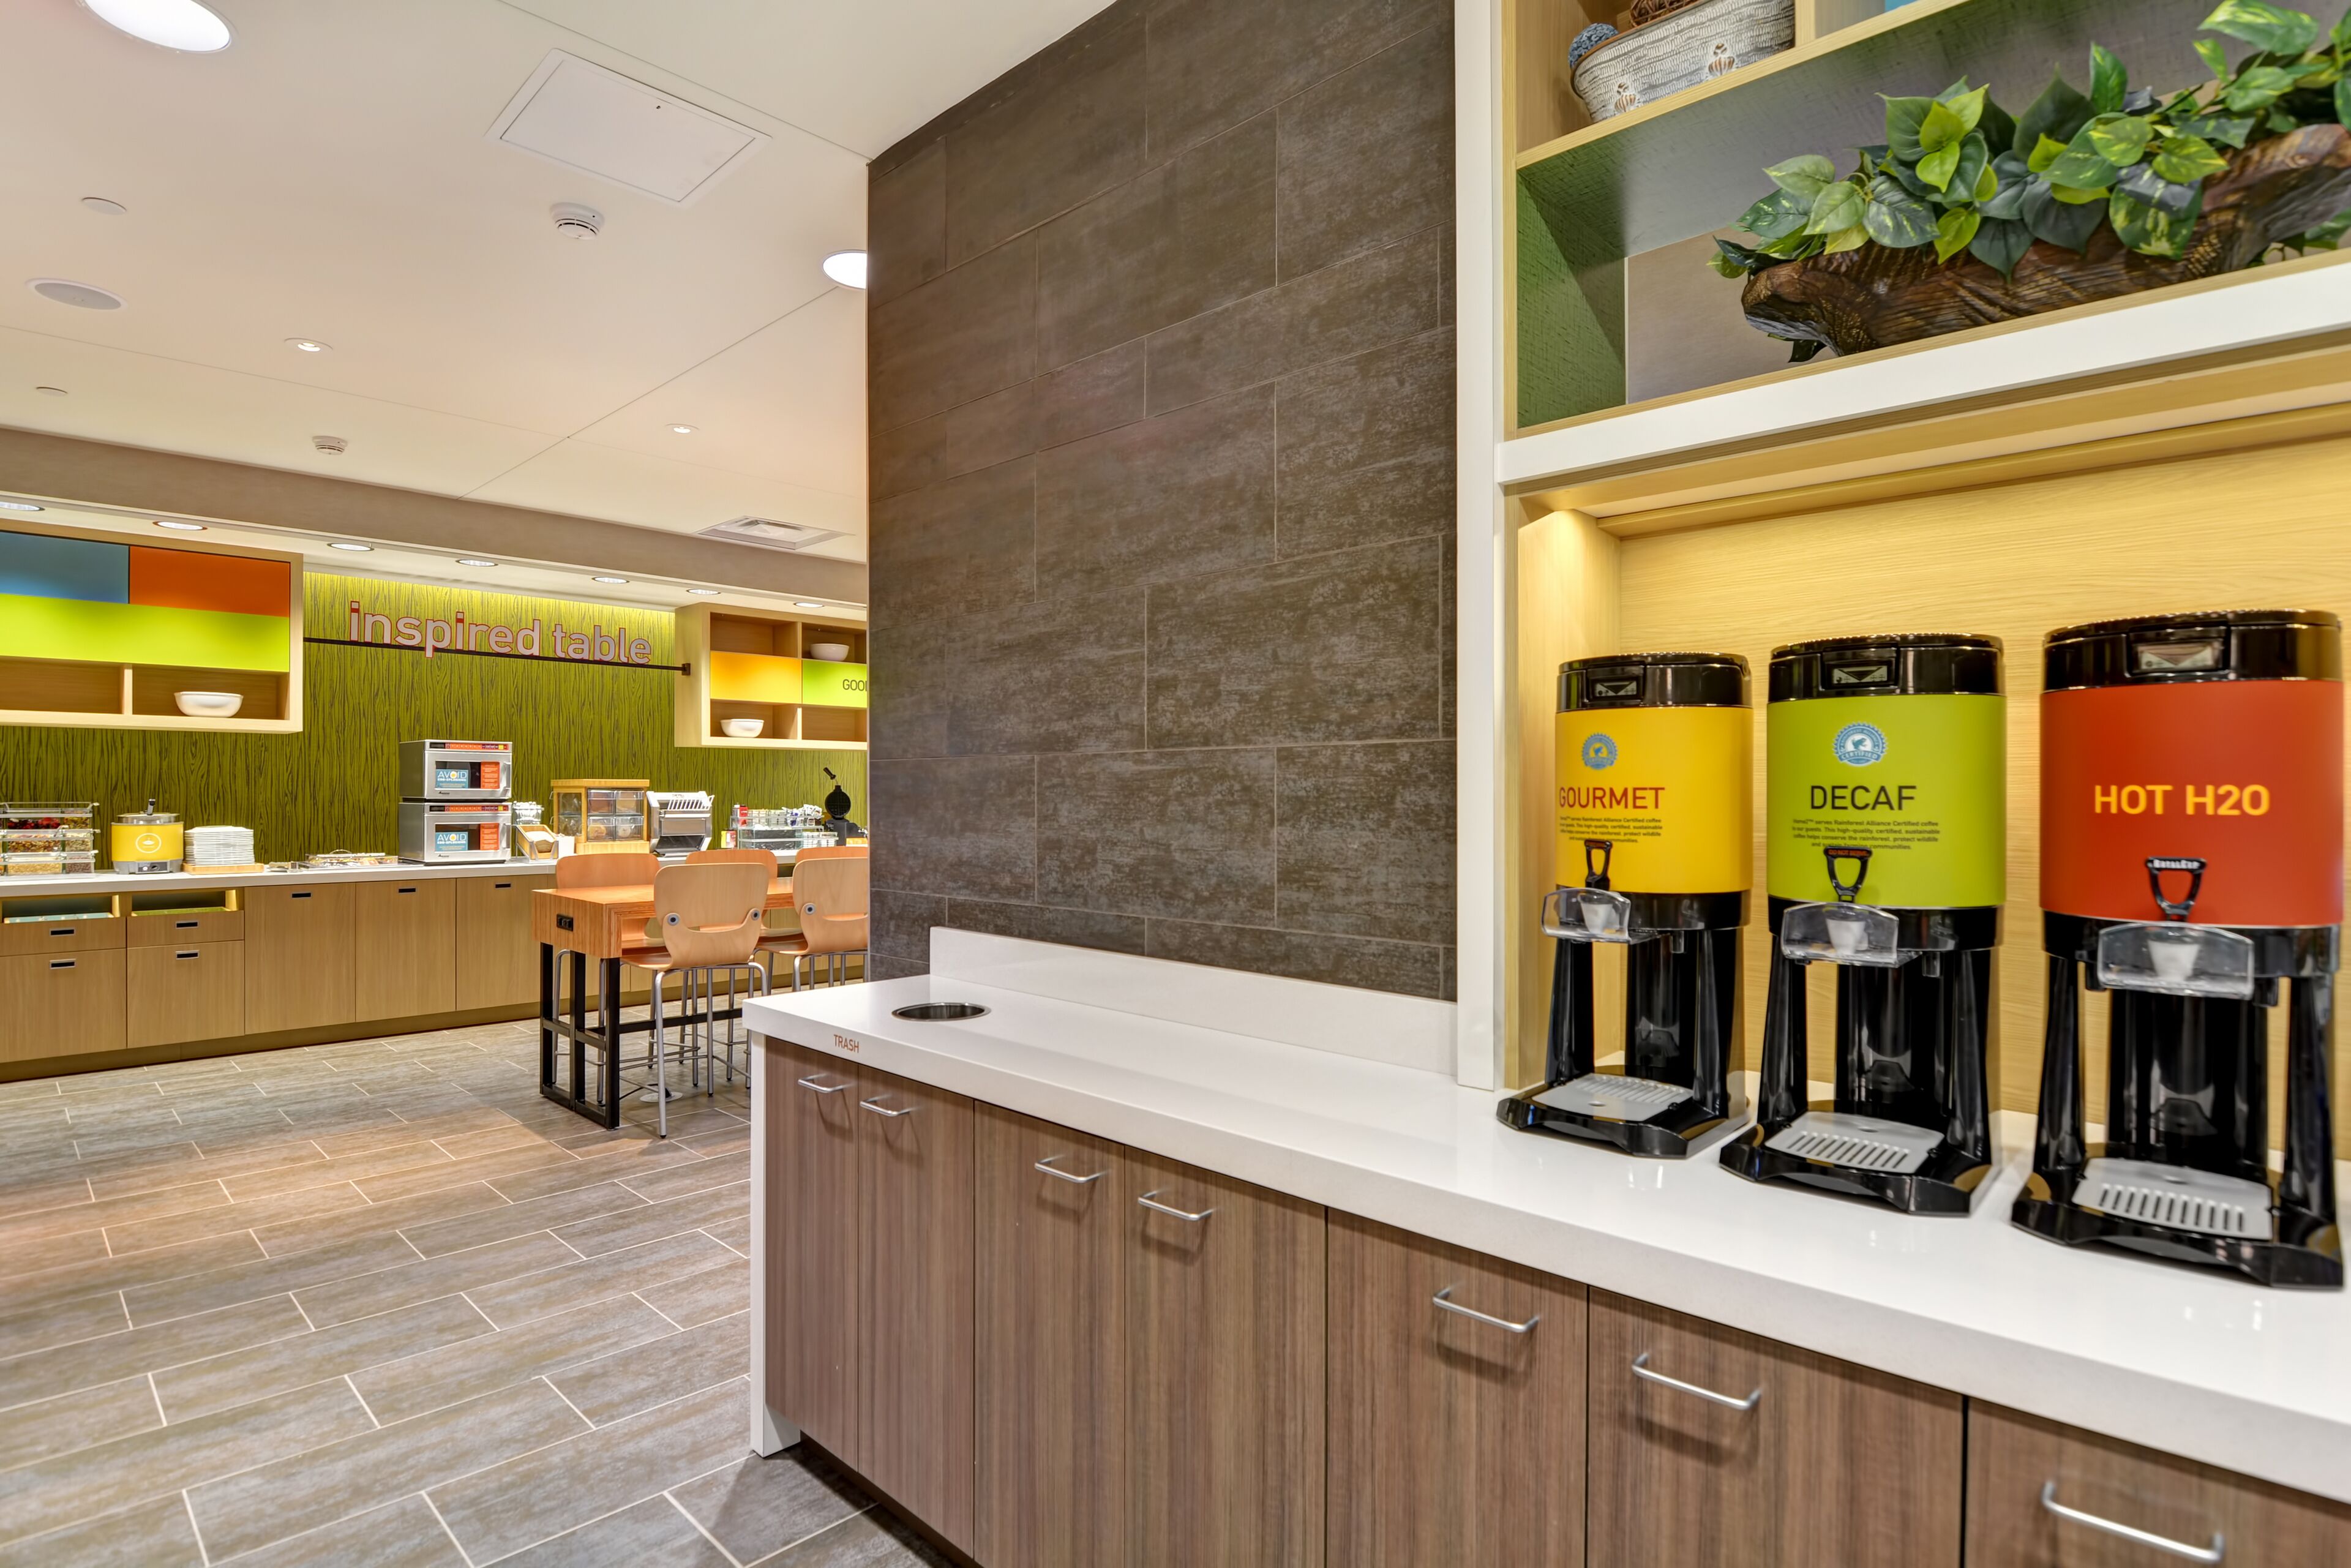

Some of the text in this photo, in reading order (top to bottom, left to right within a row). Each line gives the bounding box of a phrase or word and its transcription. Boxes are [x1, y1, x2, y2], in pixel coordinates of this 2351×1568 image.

[350, 601, 652, 664] inspired table
[842, 678, 867, 691] GOO
[1559, 787, 1665, 809] GOURMET
[1811, 786, 1917, 811] DECAF
[2095, 784, 2173, 814] HOT
[834, 1034, 860, 1054] TRASH
